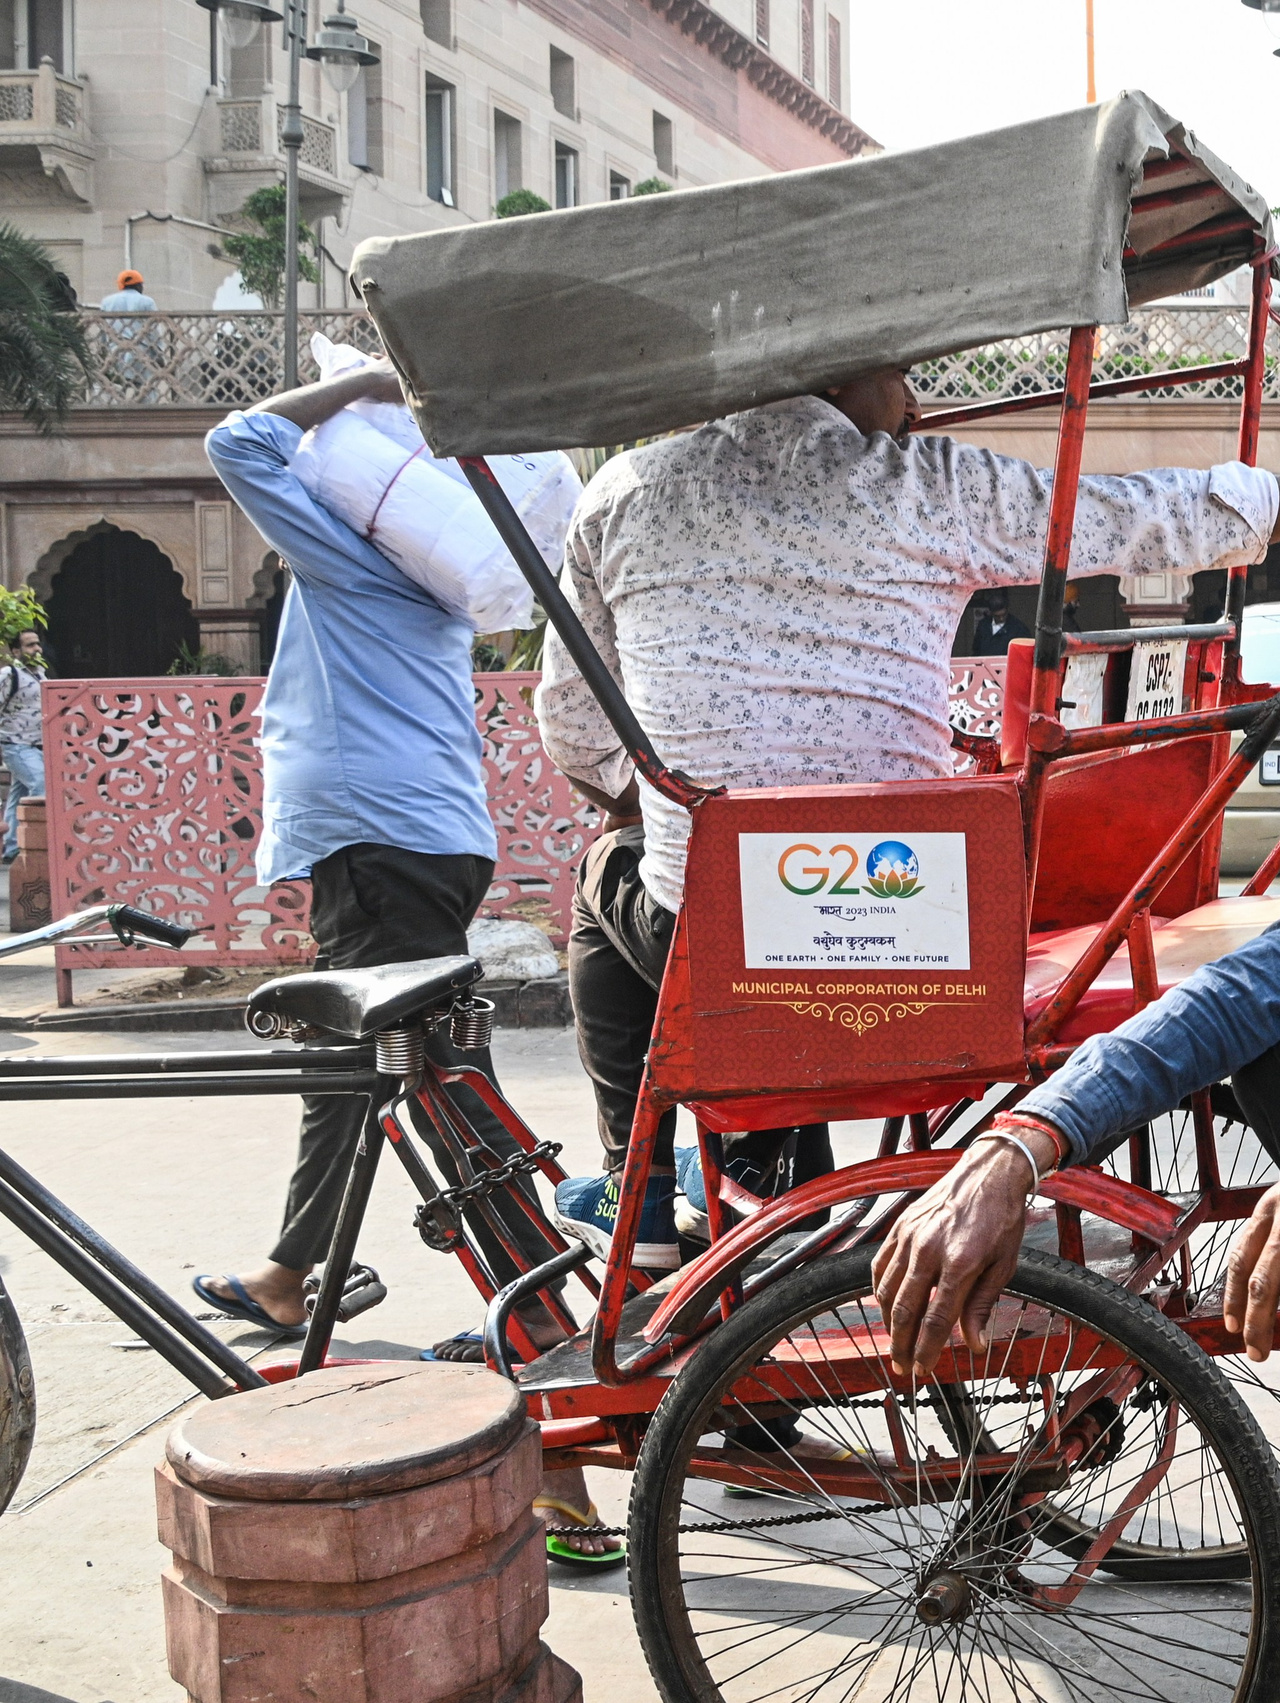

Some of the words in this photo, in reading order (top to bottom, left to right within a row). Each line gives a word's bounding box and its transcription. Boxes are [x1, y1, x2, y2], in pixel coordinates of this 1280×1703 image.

[846, 907, 868, 917] 2023
[870, 906, 896, 914] INDIA
[914, 955, 949, 963] FUTURE
[732, 982, 813, 995] MUNICIPAL
[816, 983, 918, 995] CORPORATION
[922, 984, 941, 995] OF
[945, 984, 986, 996] DELHI
